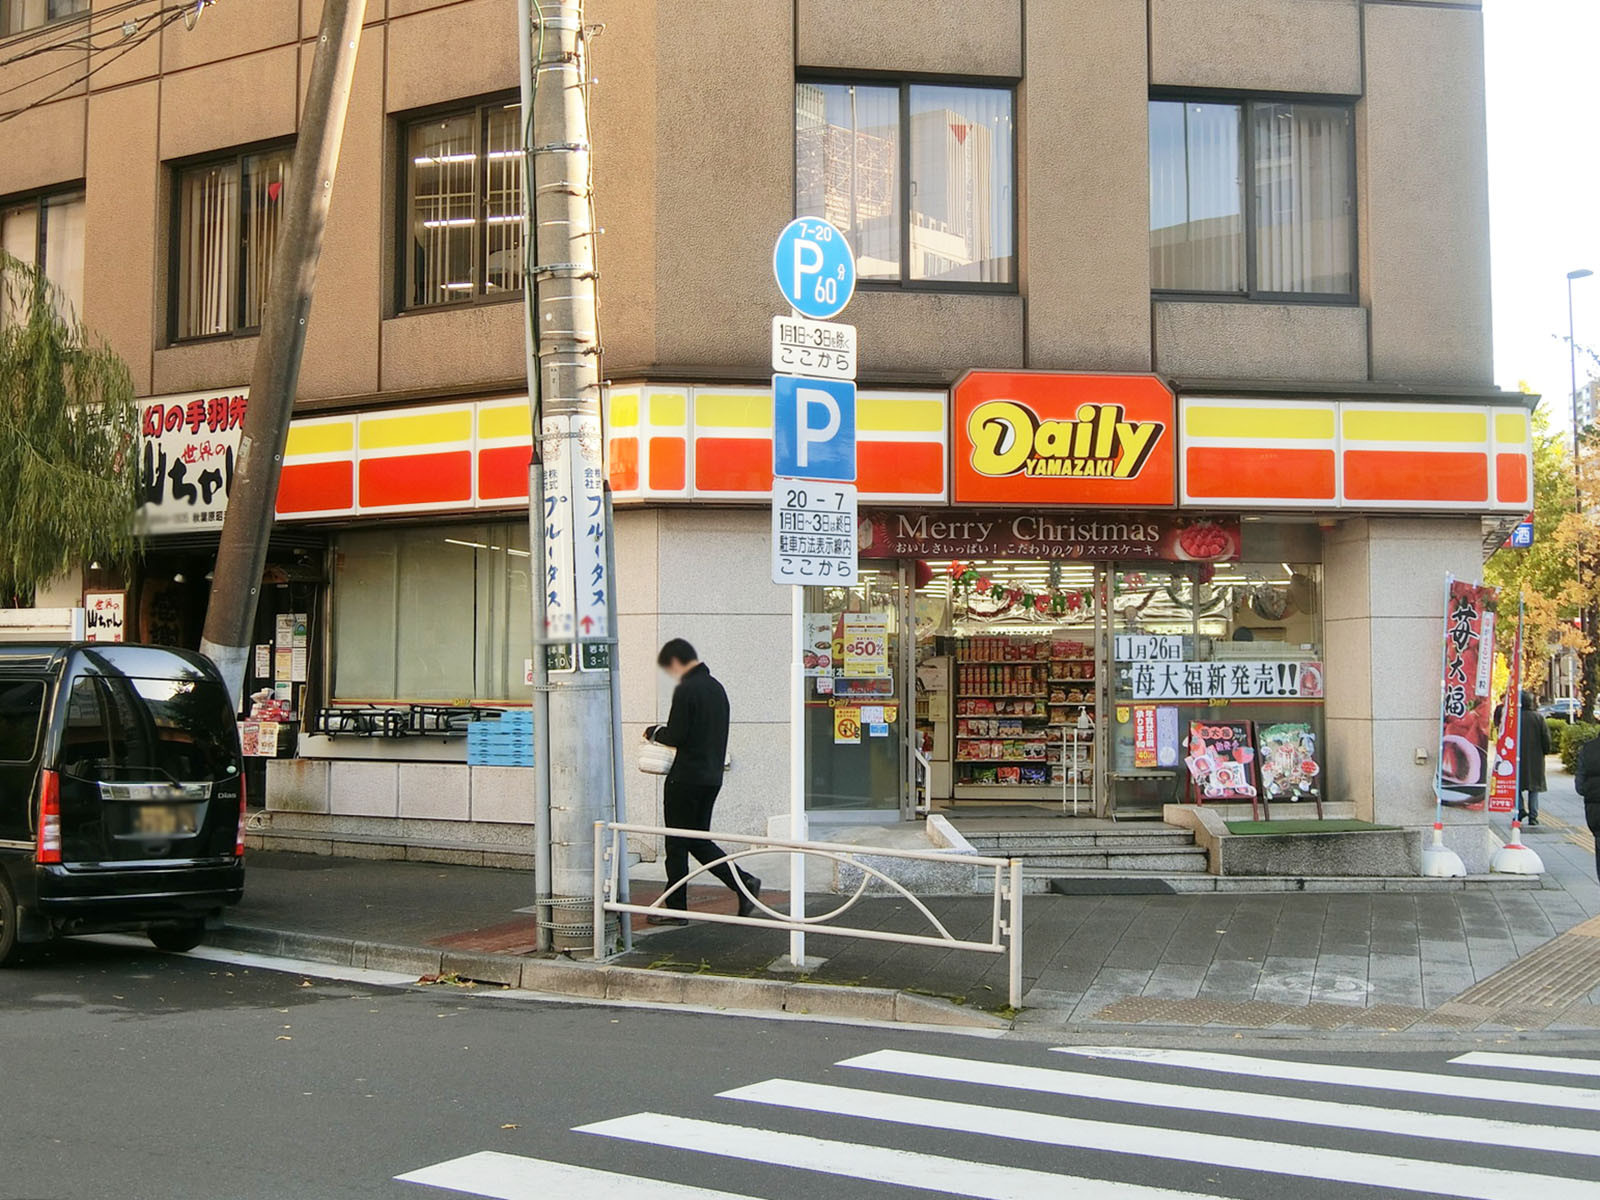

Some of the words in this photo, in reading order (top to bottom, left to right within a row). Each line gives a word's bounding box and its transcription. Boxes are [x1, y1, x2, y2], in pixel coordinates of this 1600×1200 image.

[800, 222, 833, 242] 7-20
[794, 238, 824, 300] P
[781, 347, 849, 371] ここから
[142, 396, 248, 439] 幻の手羽先
[796, 387, 841, 468] P
[181, 440, 225, 464] 世界の
[967, 400, 1165, 480] Daily
[1026, 458, 1114, 477] YAMAZAKI
[896, 514, 993, 543] Merry
[1012, 515, 1160, 542] Christmas
[1514, 527, 1530, 544] 酒
[780, 535, 851, 555] 駐車方法表示線内
[781, 558, 850, 577] ここから
[87, 609, 122, 628] 山ちゃん
[1115, 636, 1182, 660] 11月26日
